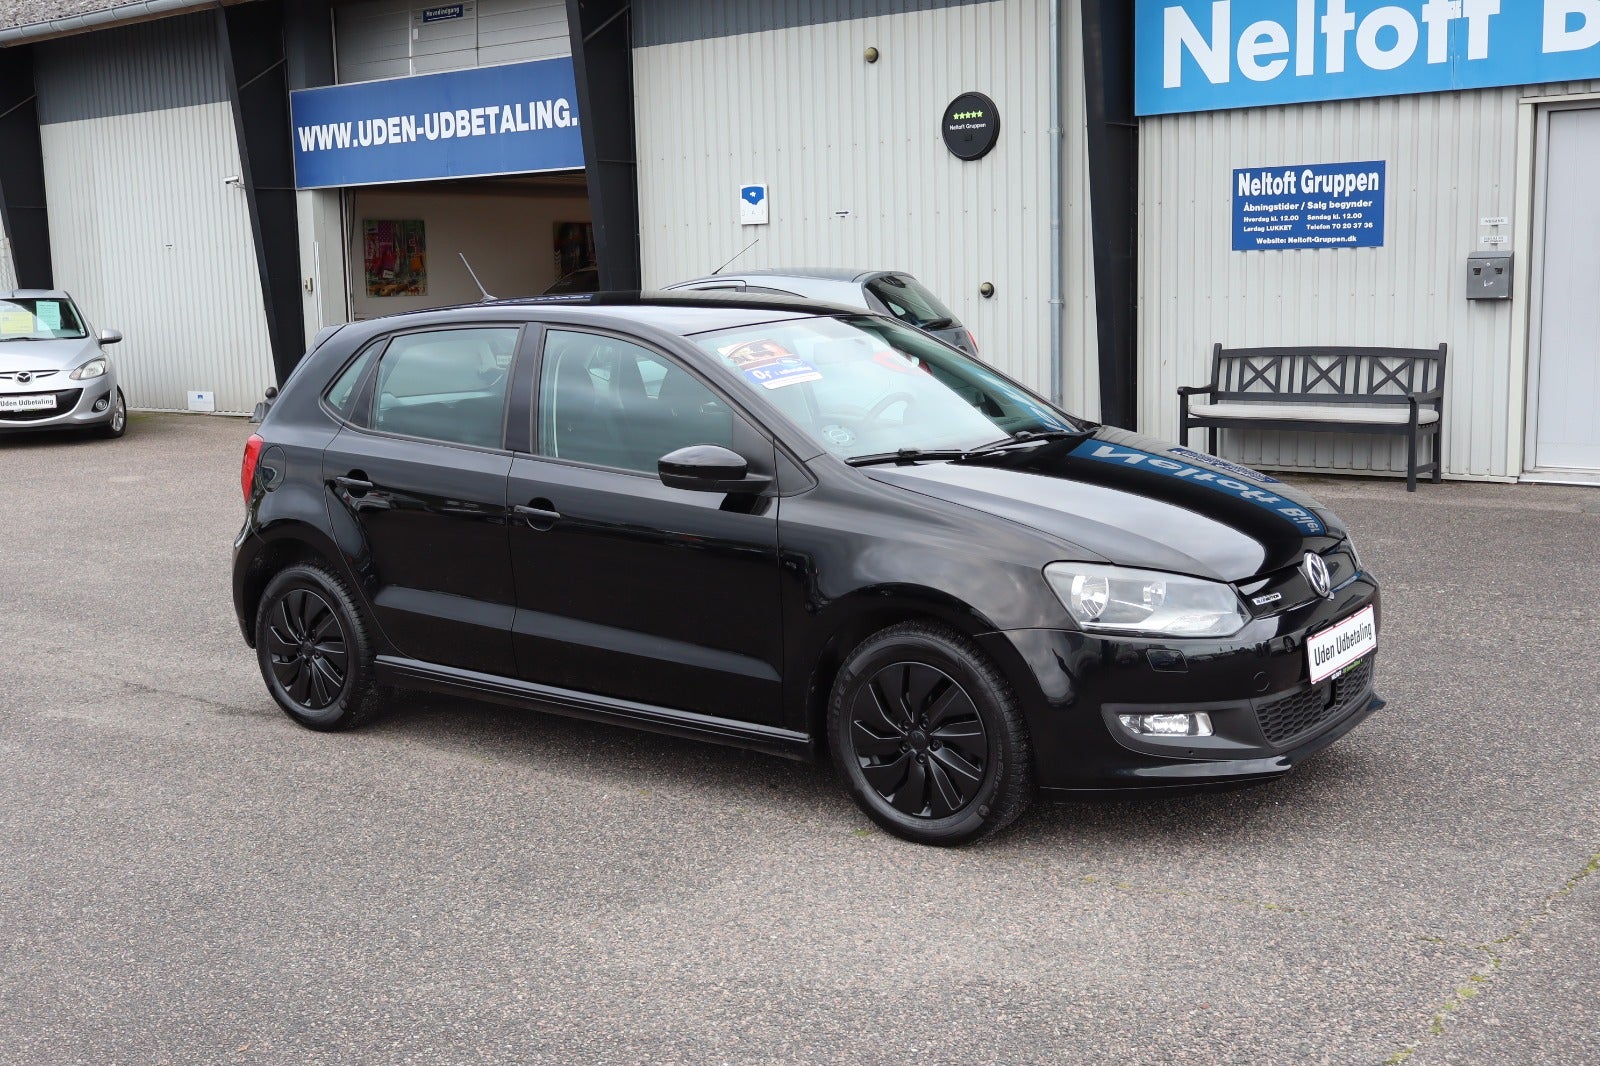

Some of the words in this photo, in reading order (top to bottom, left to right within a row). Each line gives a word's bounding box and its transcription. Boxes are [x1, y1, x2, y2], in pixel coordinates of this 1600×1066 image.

[1163, 0, 1500, 89] Neltoft
[298, 97, 578, 152] WWW.UDEN-UDBETALING.
[1238, 171, 1297, 197] Neltoft
[1301, 169, 1379, 198] Gruppen
[1243, 202, 1299, 213] Åbningstider
[1307, 201, 1327, 211] Salg
[1329, 200, 1373, 210] begynder
[1288, 235, 1357, 244] Neltoft-Gruppen.dk
[18, 398, 54, 406] Udbetaling
[1314, 645, 1335, 667] Uden
[1335, 623, 1372, 655] Udbetaling
